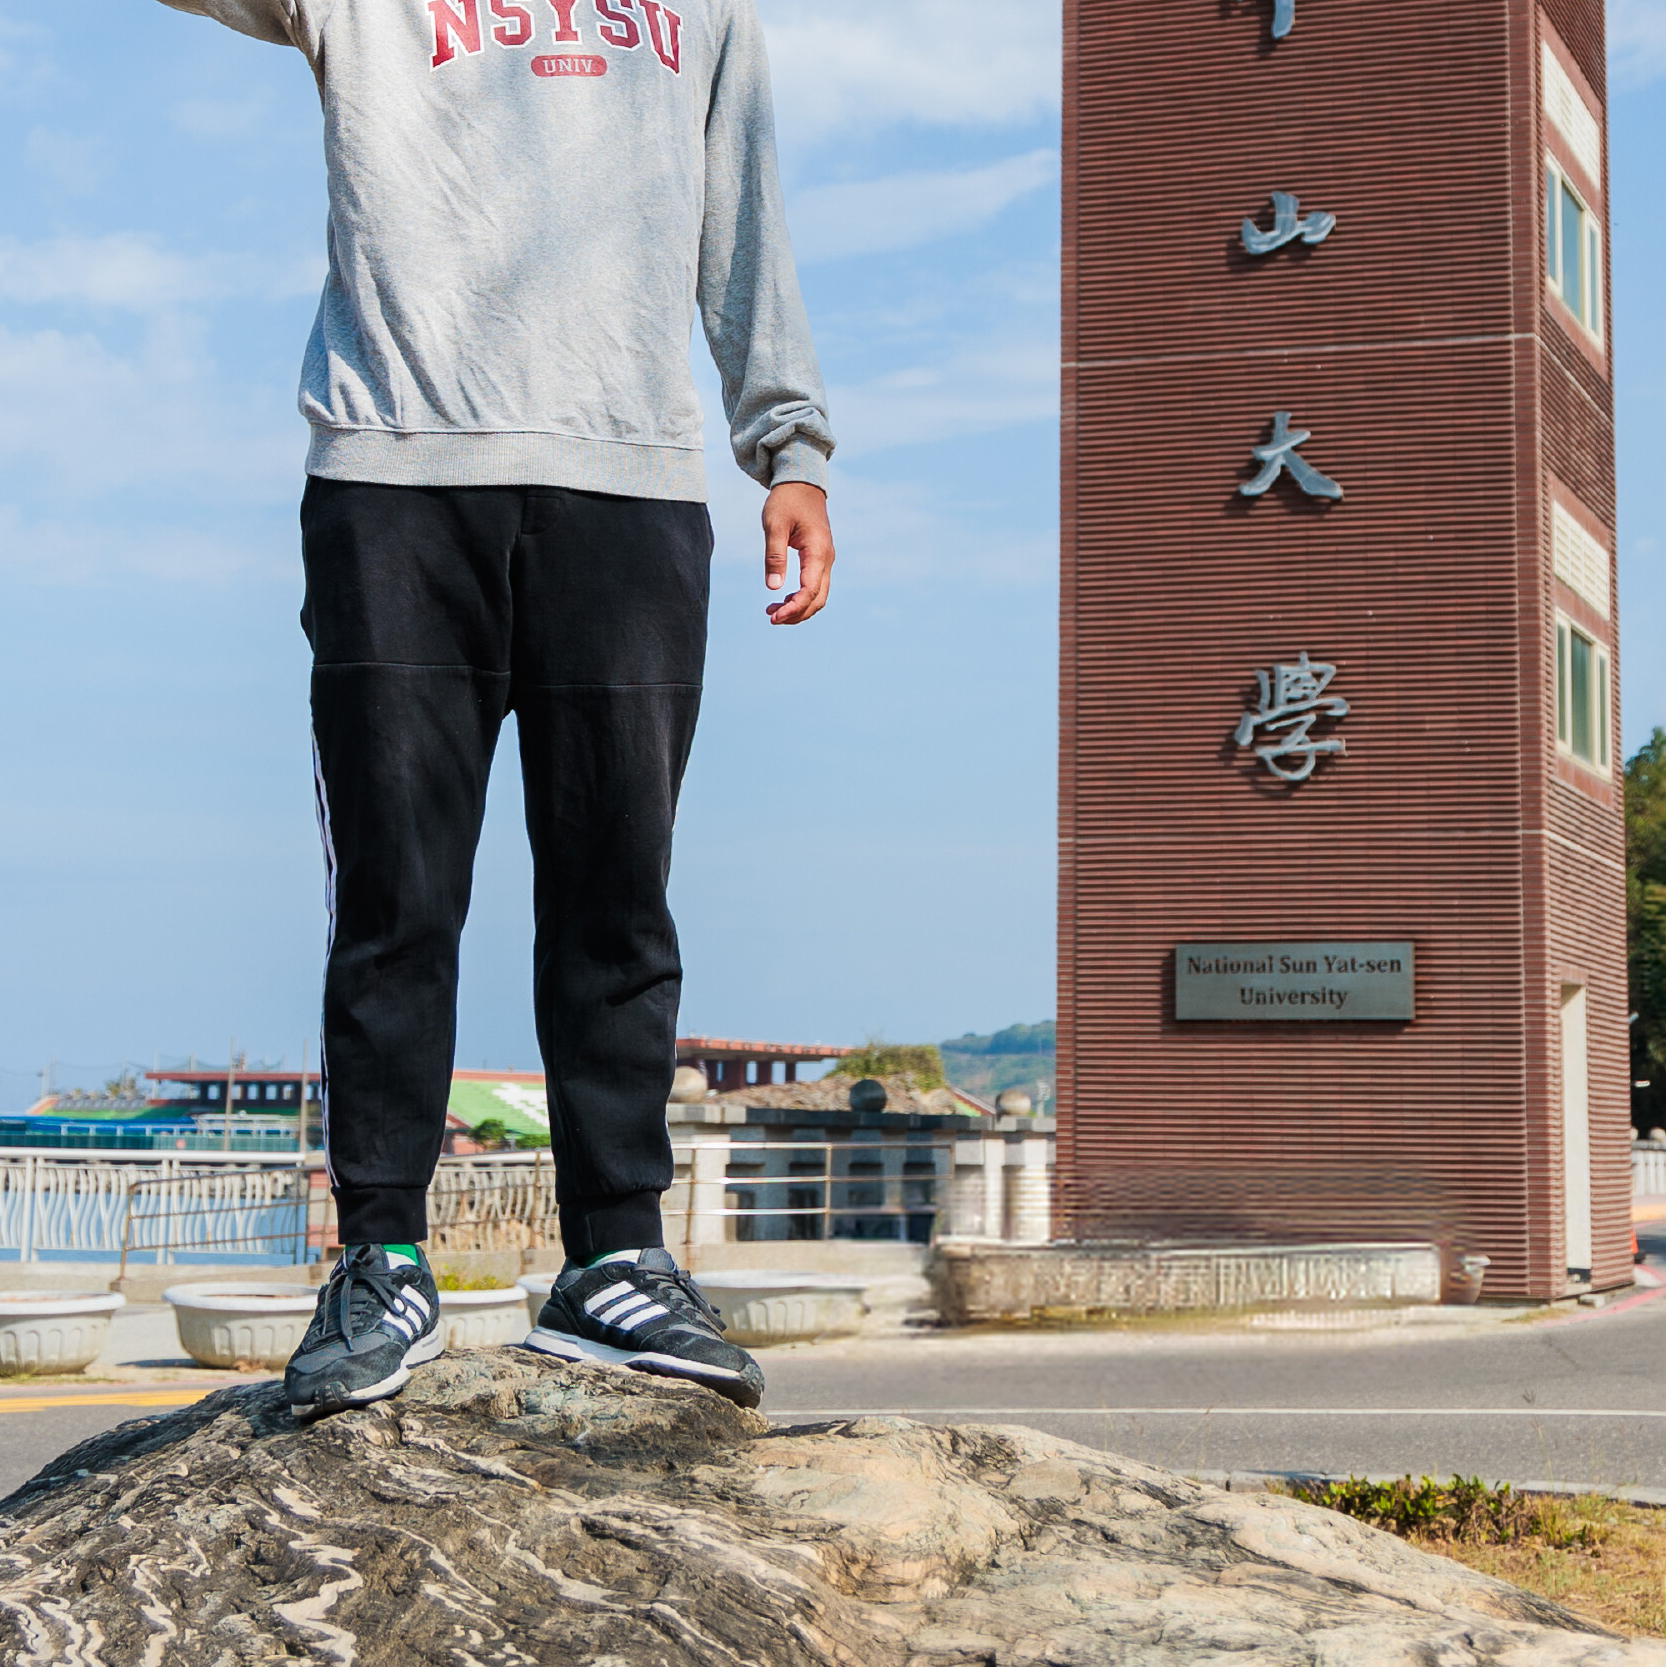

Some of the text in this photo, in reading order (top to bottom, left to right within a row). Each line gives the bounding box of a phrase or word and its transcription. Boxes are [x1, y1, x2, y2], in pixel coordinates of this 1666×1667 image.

[542, 58, 597, 73] UNIV.
[1187, 955, 1402, 974] National Sun Yat-sen
[1240, 987, 1348, 1009] University
